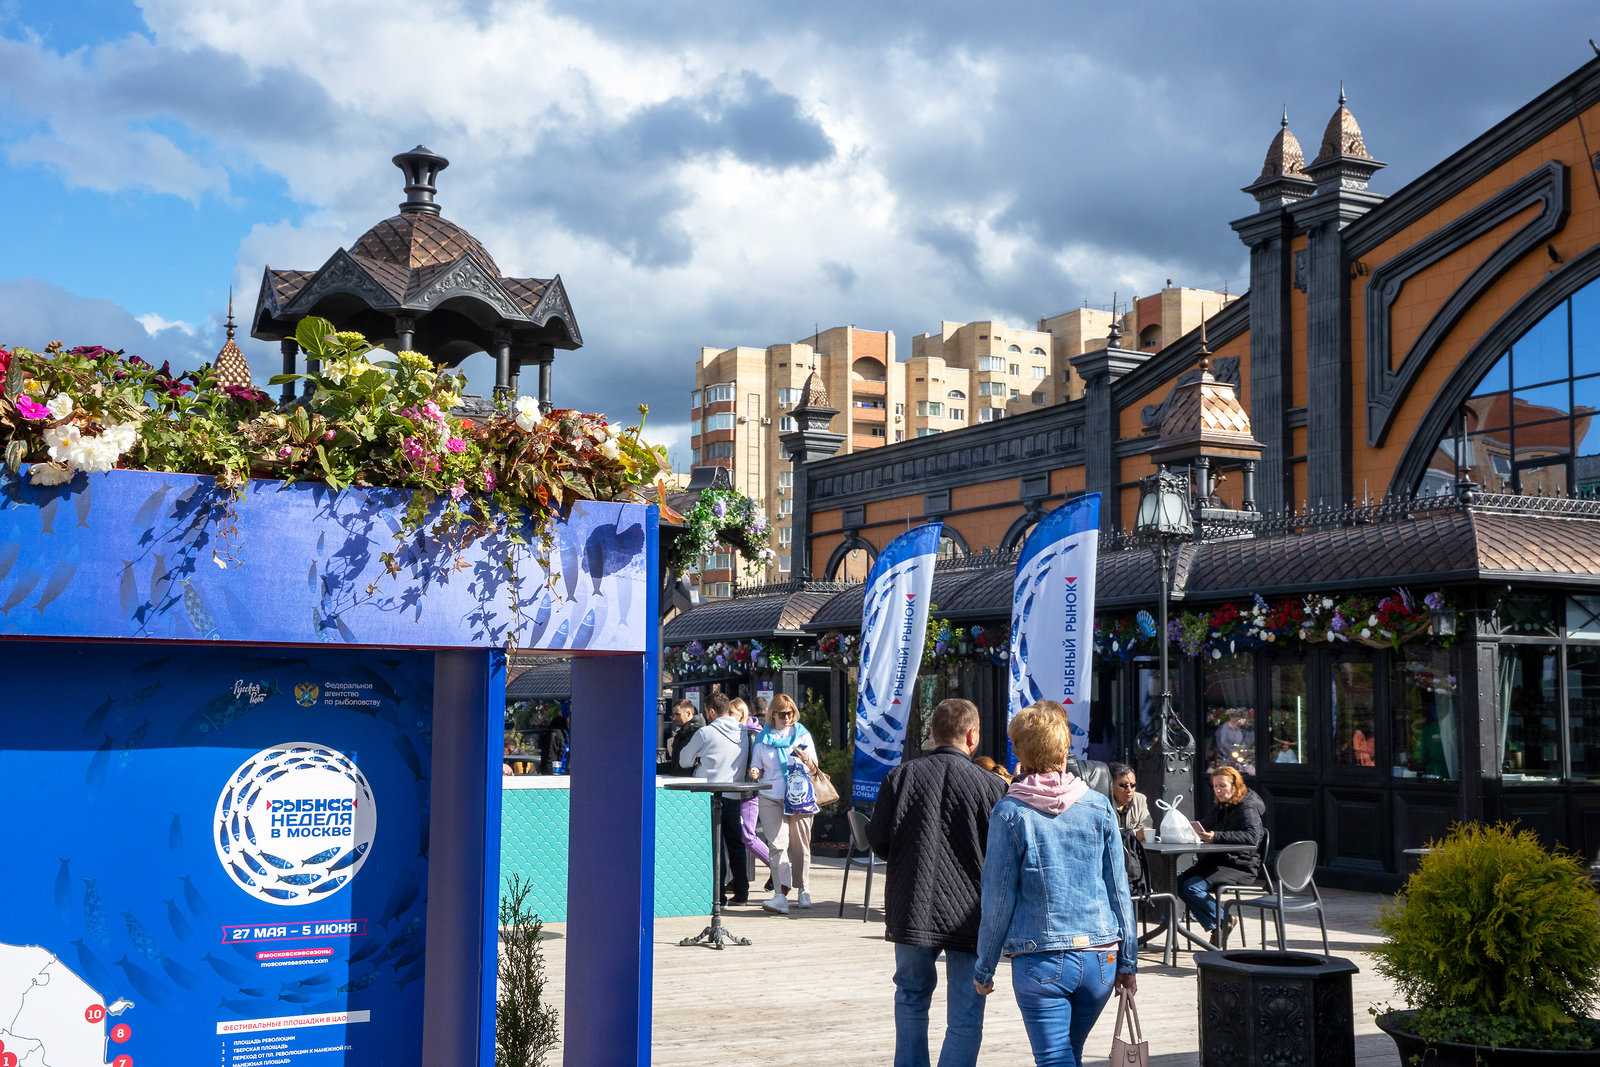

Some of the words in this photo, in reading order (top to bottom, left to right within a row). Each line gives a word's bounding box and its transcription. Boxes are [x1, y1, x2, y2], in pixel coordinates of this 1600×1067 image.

[1065, 583, 1077, 633] РЫНОК
[894, 648, 910, 696] РЫБНЫЙ
[902, 600, 916, 642] РЫНОК
[1062, 638, 1077, 696] РЫБНЫЙ
[324, 682, 373, 690] Федеральное
[272, 798, 352, 812] РЫБНАЯ
[272, 813, 352, 826] НЕДЕЛЯ
[271, 828, 280, 838] В
[232, 929, 250, 940] 27
[254, 926, 286, 938] МАЯ
[302, 925, 311, 935] 5
[315, 923, 358, 934] ИЮНЯ
[260, 958, 329, 968] moscowseasons.com
[88, 1009, 102, 1020] 10
[223, 1022, 282, 1031] ФЕСТИВАЛЬНЫЕ
[283, 1016, 325, 1027] ПЛОЩАДКИ
[326, 1015, 332, 1023] В
[116, 1028, 124, 1038] 8
[262, 1035, 296, 1043] РЕВОЛЮЦИИ
[232, 1053, 257, 1061] ПЕРЕХОД
[275, 1048, 309, 1057] РЕВОЛЮЦИИ
[314, 1044, 344, 1053] МАНЕЖНОЙ
[233, 1046, 260, 1054] ТВЕРСКАЯ
[3, 1057, 9, 1067] 1
[119, 1059, 127, 1067] 7
